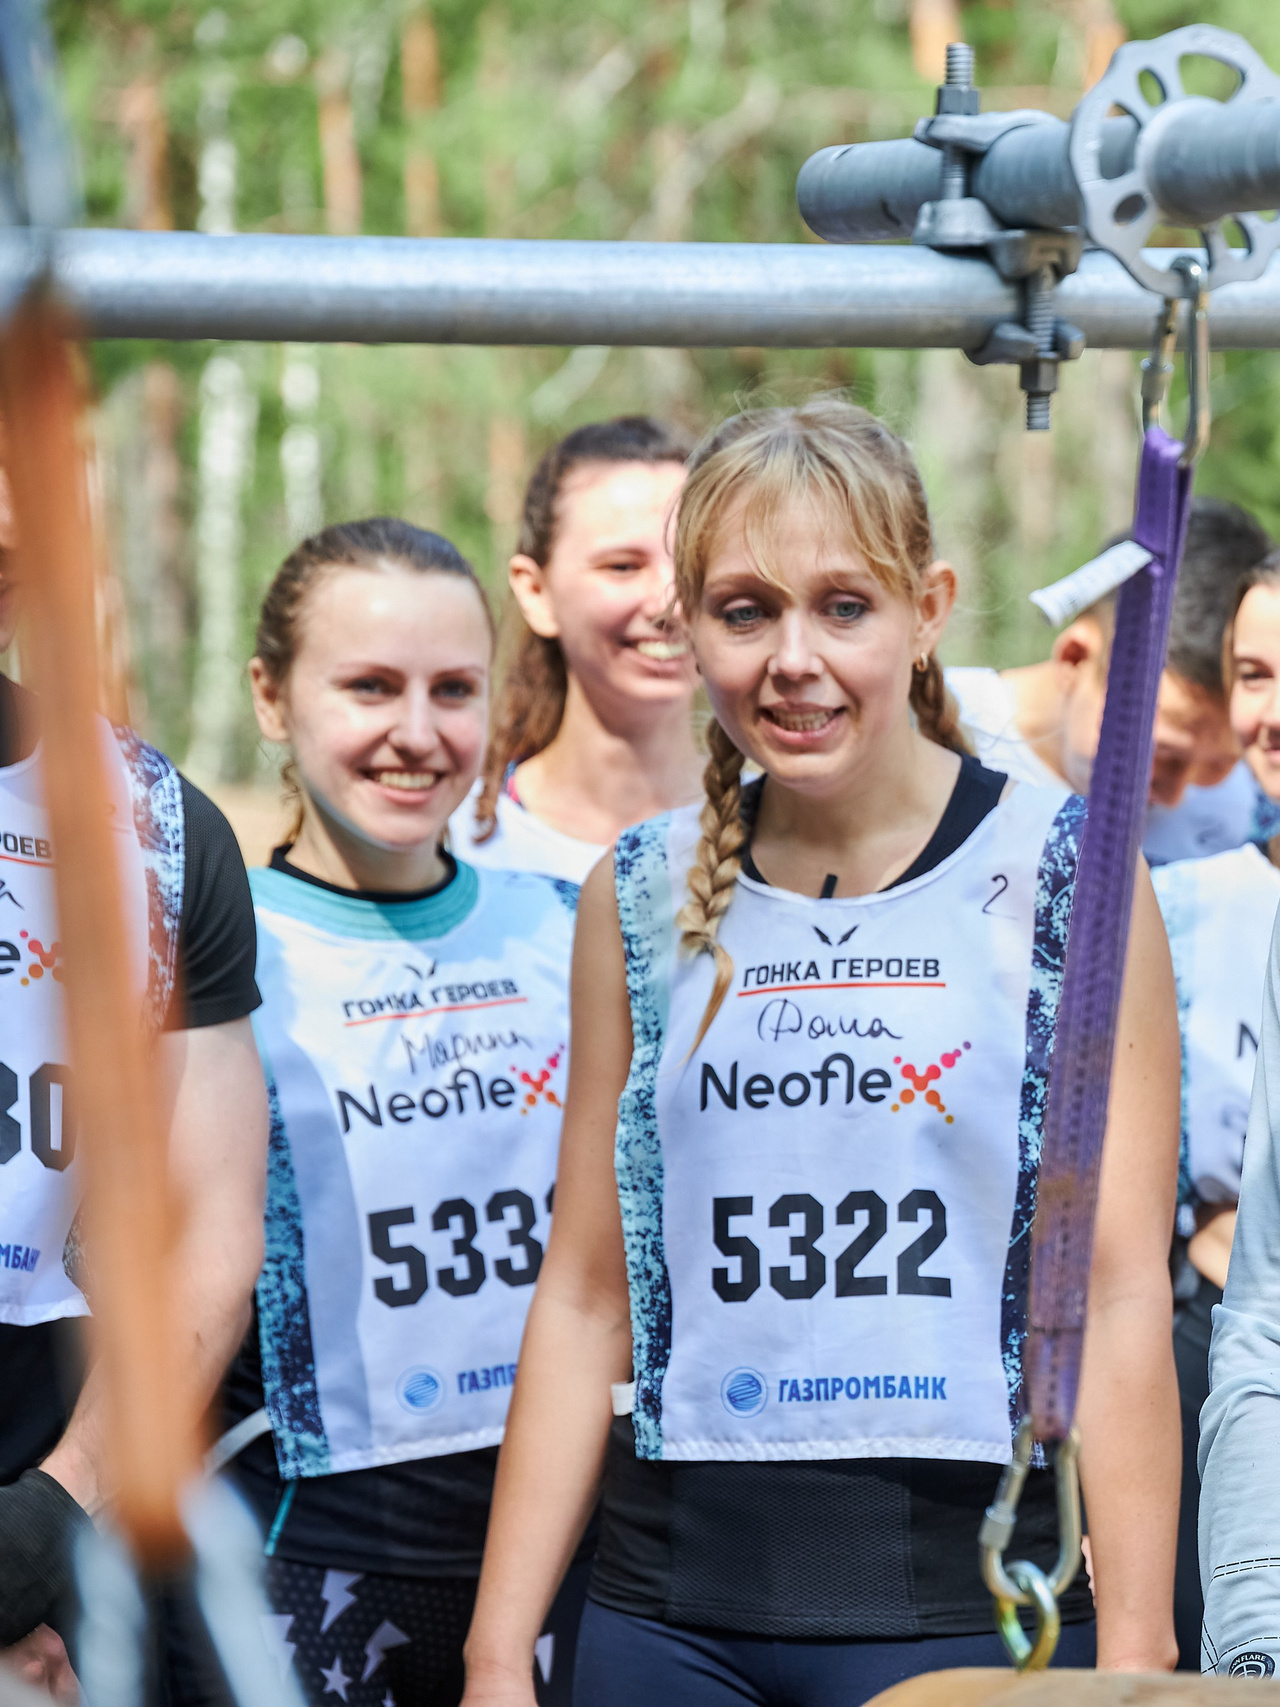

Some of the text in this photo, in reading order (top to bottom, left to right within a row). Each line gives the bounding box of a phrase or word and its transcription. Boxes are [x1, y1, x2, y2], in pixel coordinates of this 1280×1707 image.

[0, 833, 52, 859] ОЕВ
[982, 874, 1019, 921] 2
[743, 959, 940, 988] ГОНКА ГЕРОЕВ
[343, 979, 518, 1018] ГОНКА ГЕРОЕВ
[367, 1183, 555, 1309] 533
[712, 1189, 952, 1302] 5322
[778, 1375, 947, 1403] ГАЗПРОМБАНК
